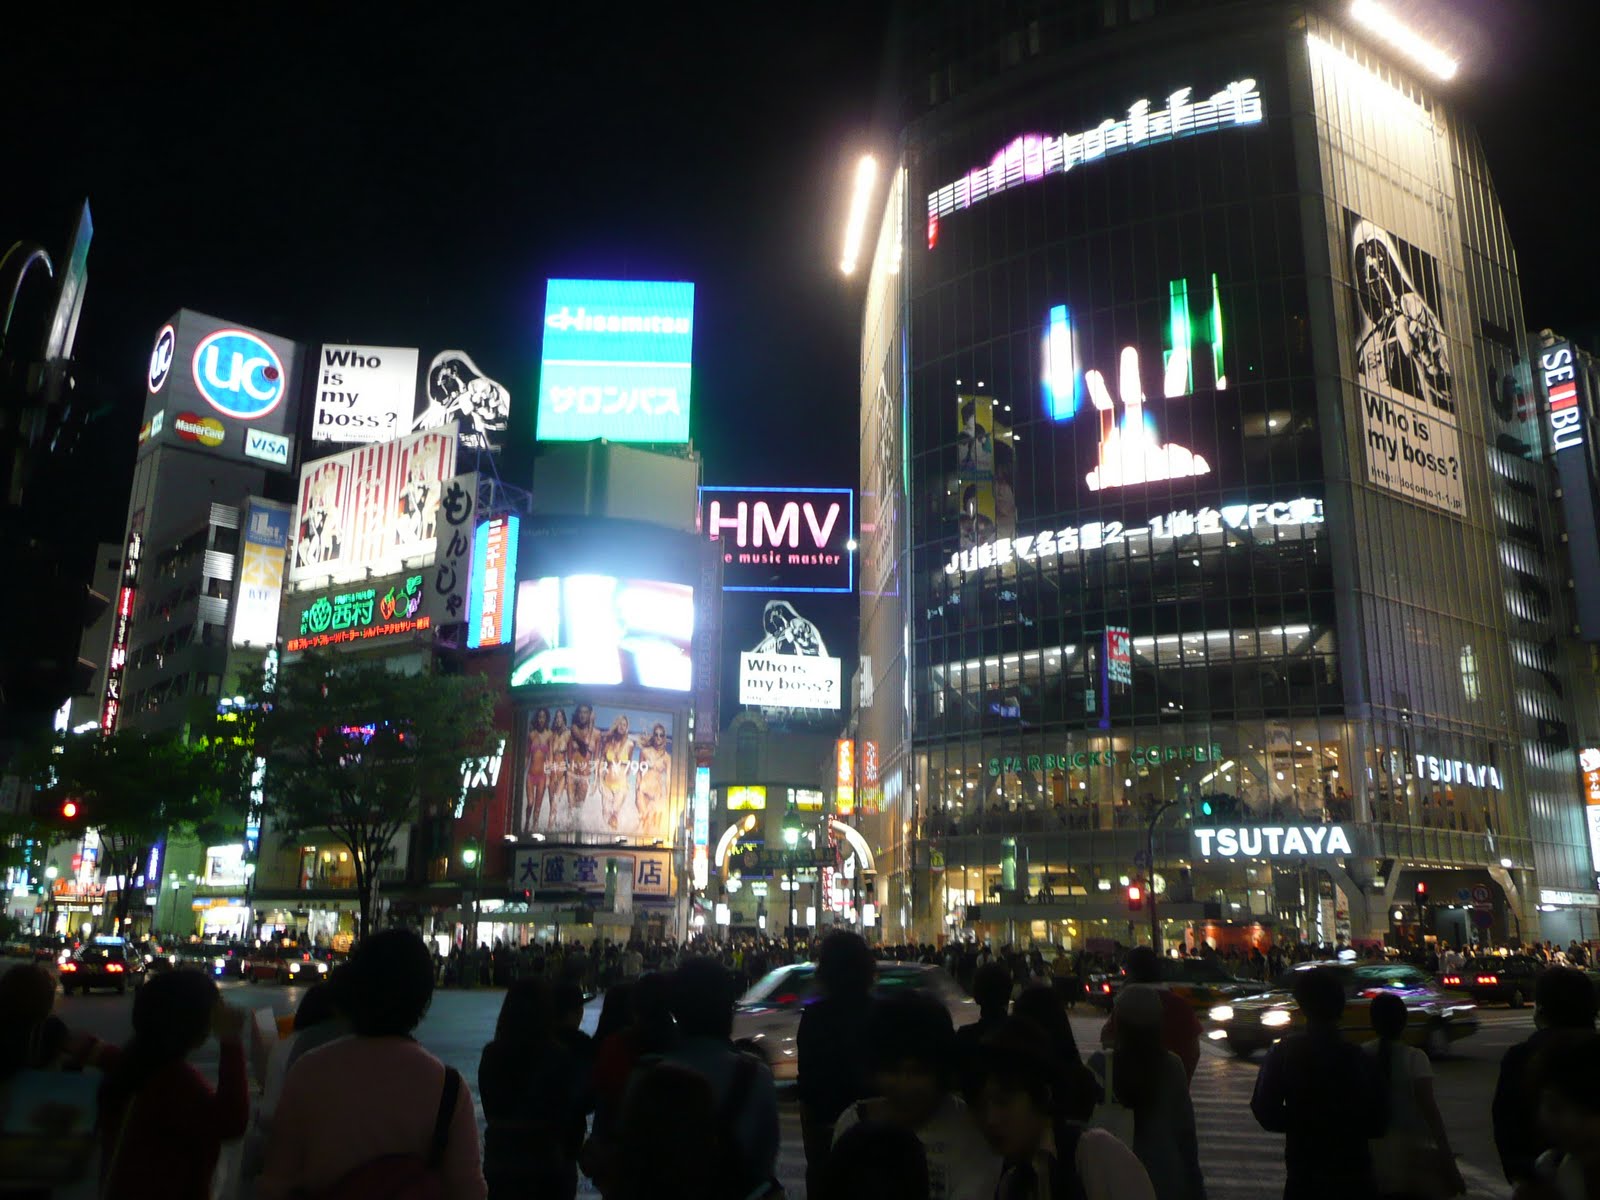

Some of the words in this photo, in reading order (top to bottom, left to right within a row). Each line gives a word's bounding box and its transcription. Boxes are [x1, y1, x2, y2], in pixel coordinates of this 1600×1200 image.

[547, 307, 689, 333] Hisamitsu
[325, 349, 381, 368] Who
[323, 370, 343, 386] is
[321, 391, 359, 408] my
[550, 386, 680, 416] サロンパス
[1543, 349, 1582, 451] SEIBU
[175, 419, 225, 441] MasterCard
[319, 409, 397, 428] boss?
[1363, 393, 1409, 432] Who
[1412, 414, 1429, 442] is
[251, 437, 287, 456] VISA
[1368, 428, 1398, 461] my
[1402, 436, 1459, 481] boss?
[709, 501, 840, 548] HMV
[436, 482, 473, 617] もんじゃ
[739, 552, 781, 564] music
[788, 553, 841, 565] master
[332, 599, 374, 630] 西村
[748, 659, 788, 673] Who
[792, 664, 806, 674] is
[747, 679, 774, 692] my
[784, 677, 834, 693] boss?
[988, 750, 1117, 777] STARBUCKS
[1130, 743, 1224, 767] COFFEE
[1415, 754, 1501, 790] TSUTAYA
[1194, 825, 1352, 856] TSUTAYA
